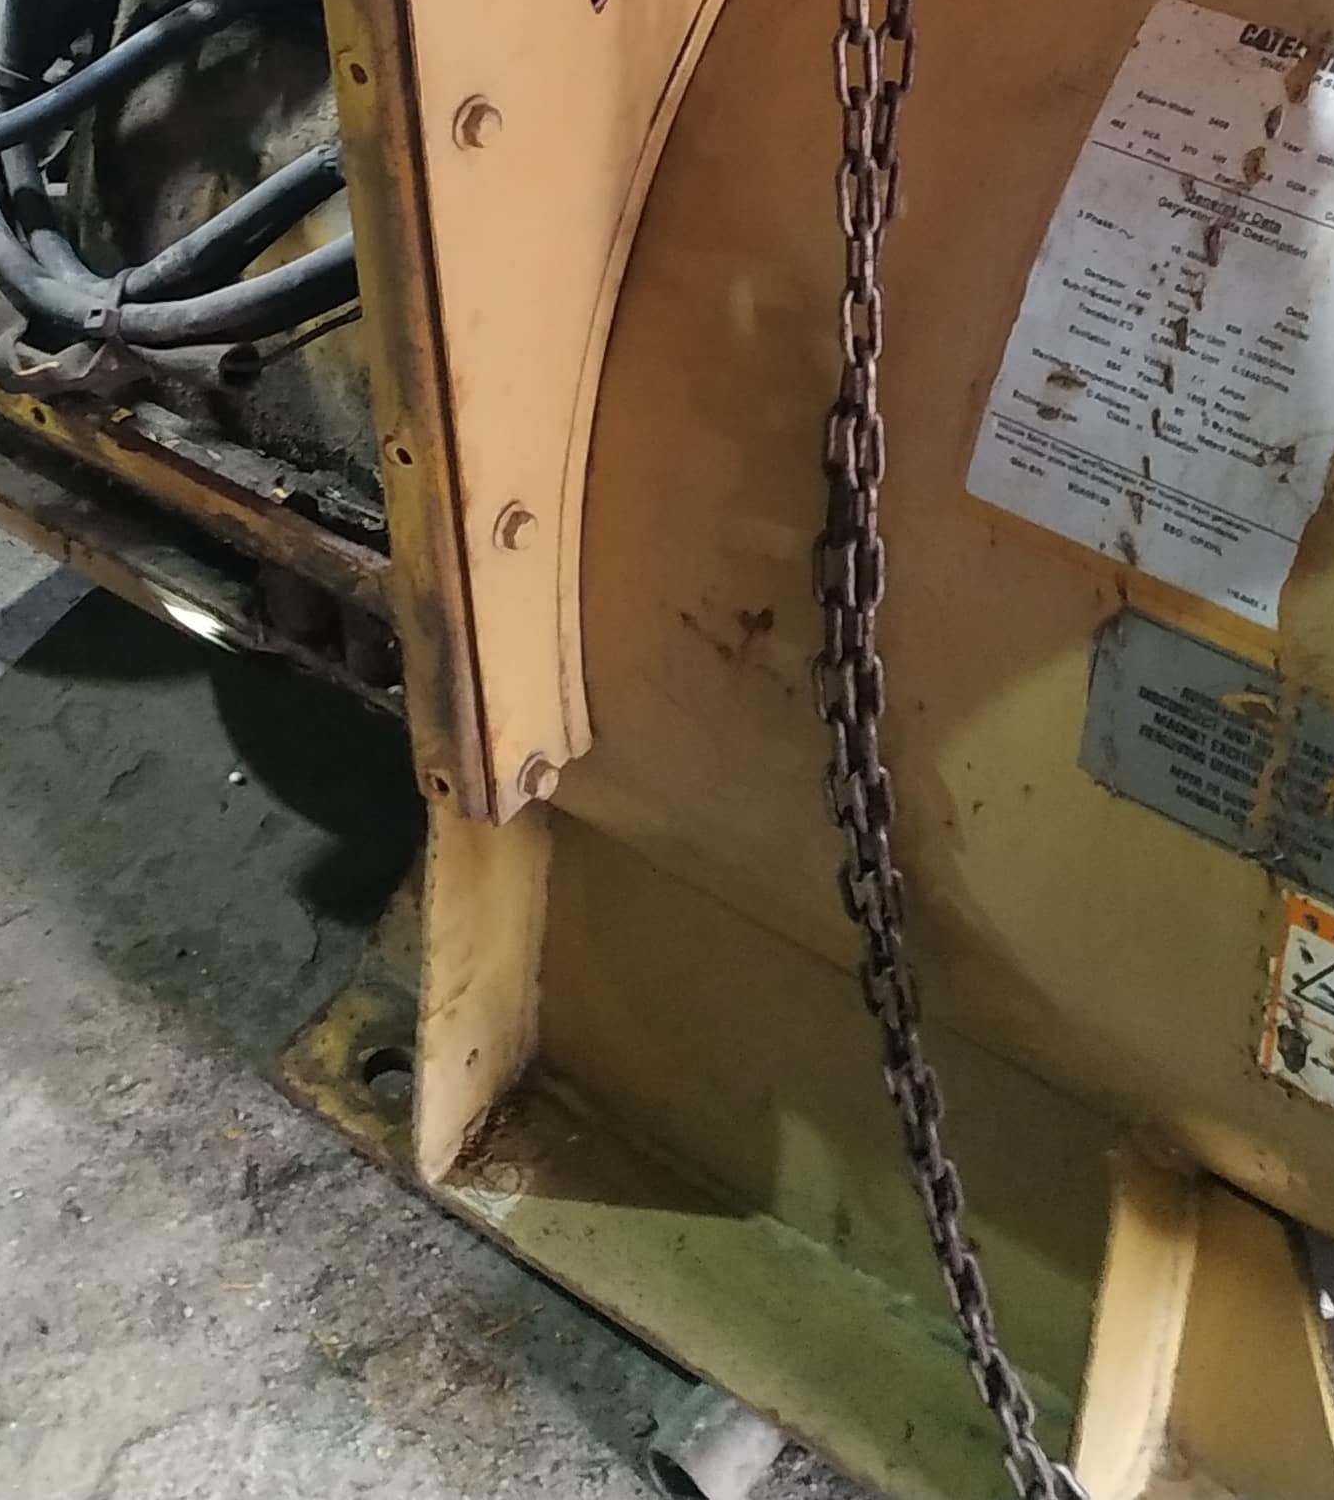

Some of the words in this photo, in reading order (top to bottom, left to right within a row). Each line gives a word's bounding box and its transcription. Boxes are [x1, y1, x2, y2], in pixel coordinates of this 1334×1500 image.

[1186, 188, 1250, 220] Generatr
[1250, 212, 1284, 232] Data
[1240, 226, 1309, 259] Description
